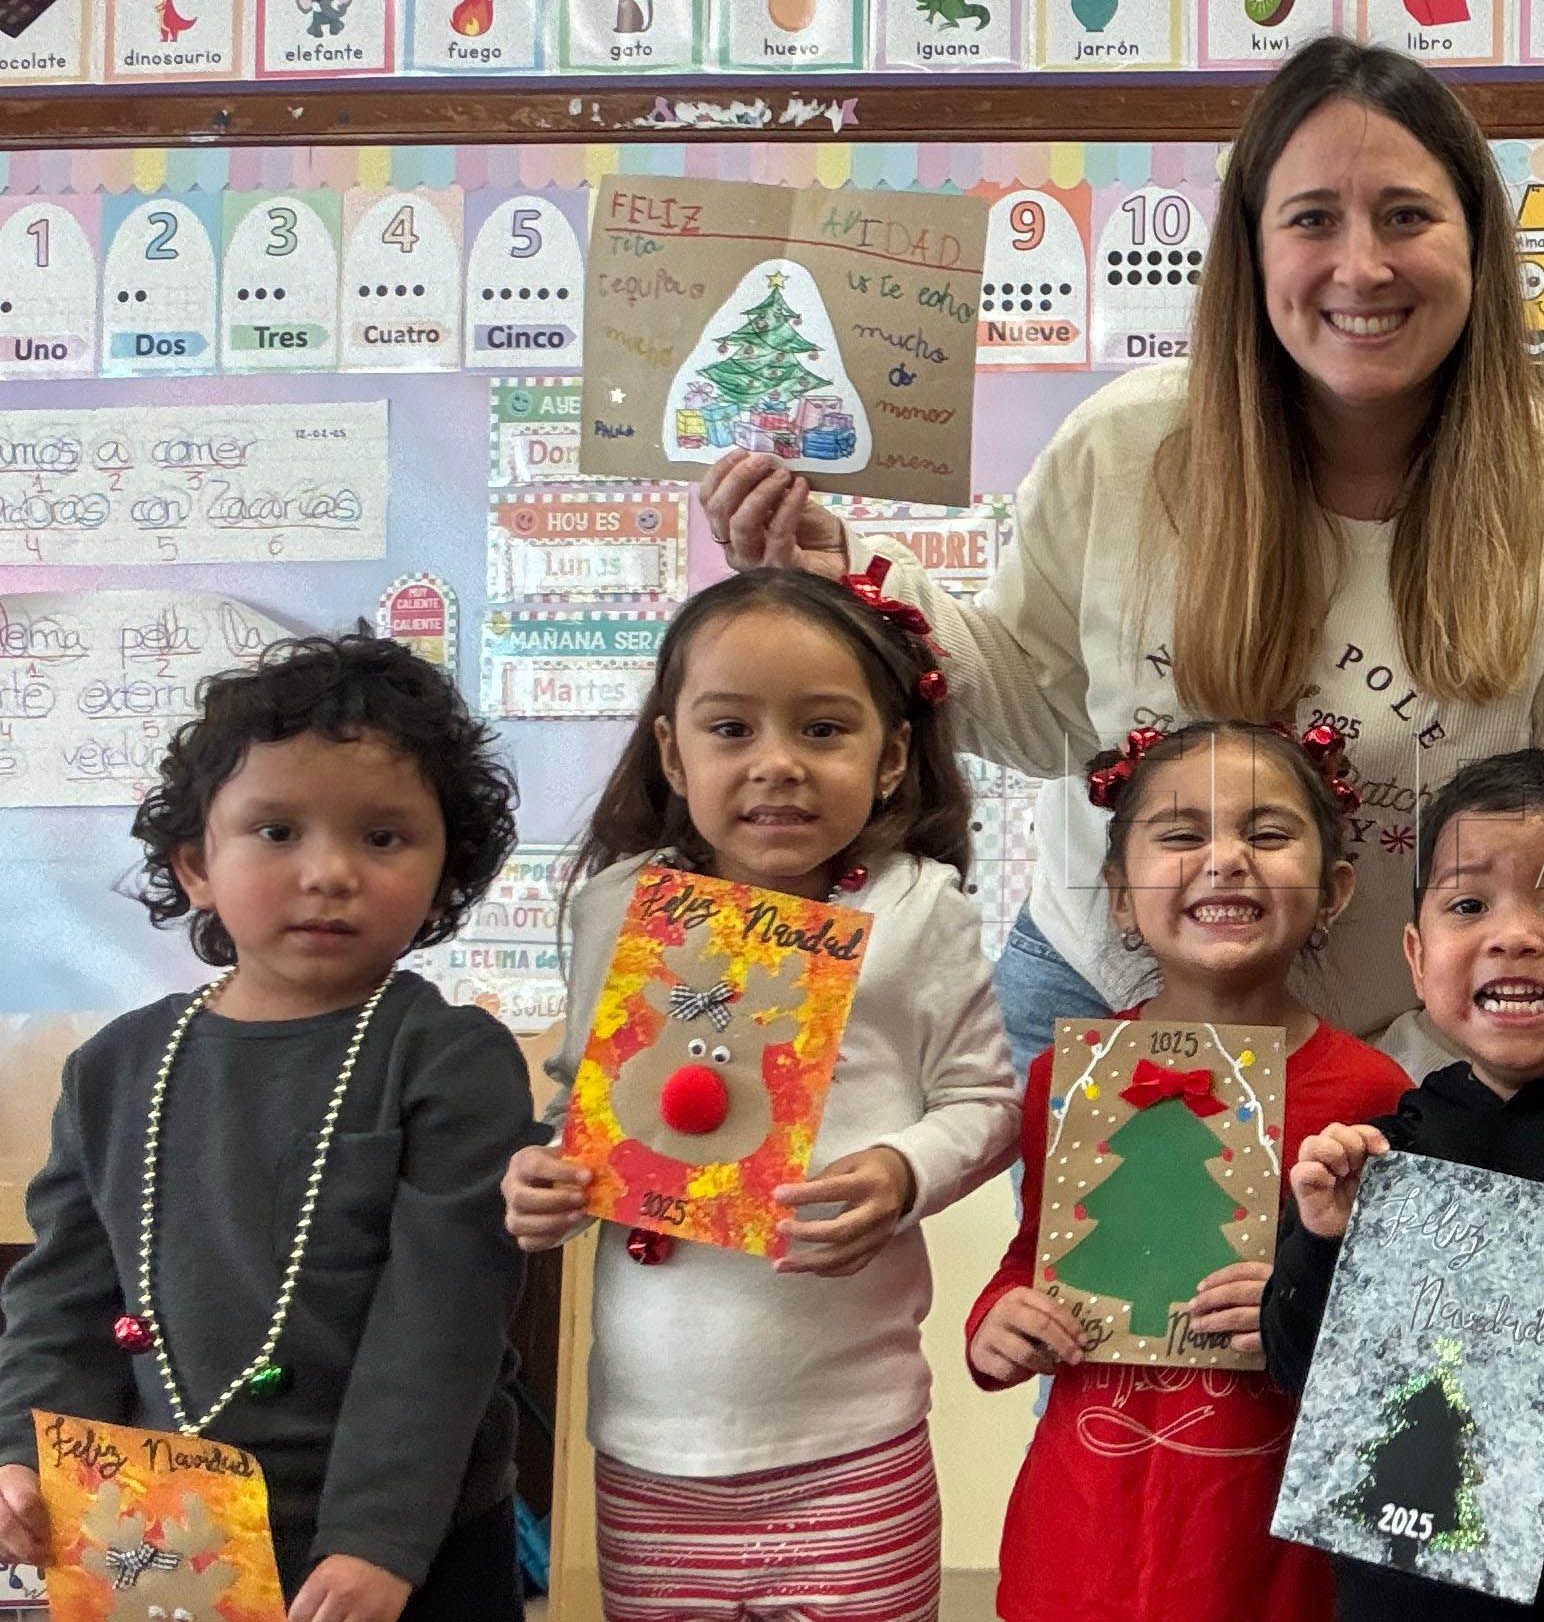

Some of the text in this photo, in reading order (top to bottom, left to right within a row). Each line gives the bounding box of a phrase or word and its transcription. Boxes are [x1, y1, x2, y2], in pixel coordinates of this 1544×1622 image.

[285, 42, 363, 62] elefante
[449, 42, 502, 63] fuego
[610, 41, 653, 60] gato
[764, 39, 820, 57] huevo
[917, 40, 980, 60] iguana
[1074, 40, 1139, 60] jarrón
[1251, 33, 1290, 50] kiwi
[1407, 33, 1453, 50] libro
[124, 49, 222, 67] dinosaurio
[266, 207, 298, 257] 3
[382, 205, 420, 254] 4
[612, 191, 961, 268] FELIZ AVIDAD
[1010, 200, 1045, 251] 9
[1122, 195, 1190, 246] 10
[27, 220, 49, 268] 1
[146, 212, 180, 260] 2
[510, 209, 542, 258] 5
[253, 325, 309, 348] Tres
[363, 324, 440, 345] Cuatro
[487, 327, 565, 349] Cinco
[988, 321, 1071, 342] Nueve
[14, 338, 69, 361] Uno
[135, 334, 187, 357] Dos
[852, 323, 950, 364] mucho
[1127, 335, 1189, 358] Diez
[540, 396, 582, 415] AYE
[547, 511, 620, 532] HOY ES
[396, 598, 441, 610] CALIENTE
[393, 618, 442, 632] CALIENTE
[509, 626, 606, 650] MAÑANA
[1336, 643, 1447, 750] POLE
[45, 1416, 128, 1479] Feliz
[1376, 1502, 1435, 1540] 2025
